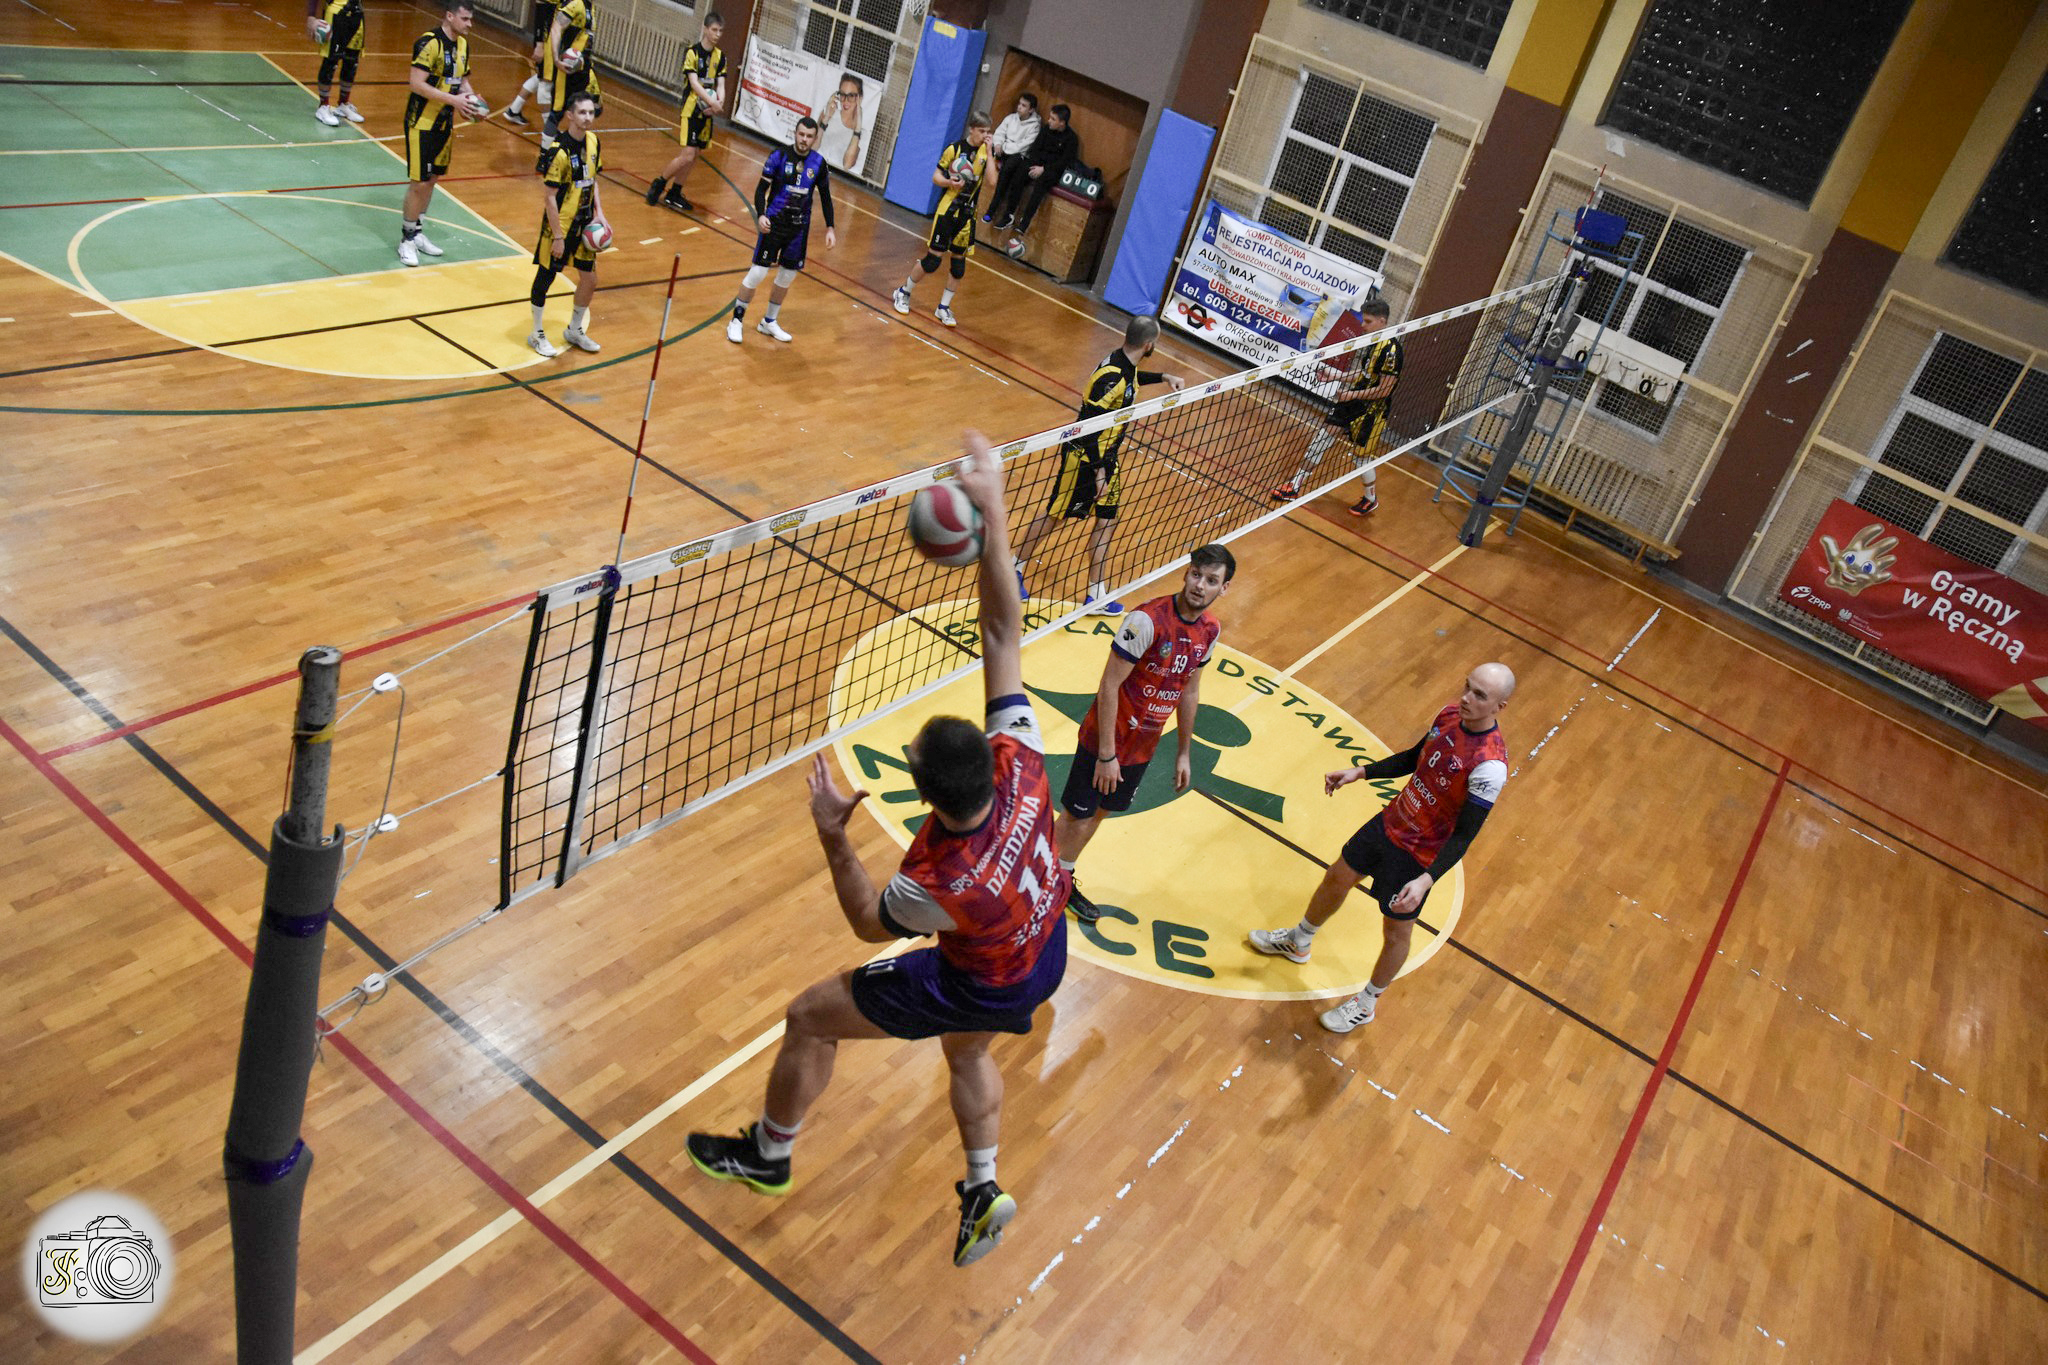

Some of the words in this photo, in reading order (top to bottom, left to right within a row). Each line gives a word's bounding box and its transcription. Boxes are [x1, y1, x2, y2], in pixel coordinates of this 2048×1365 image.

[1062, 173, 1073, 184] 0
[1087, 184, 1097, 195] 0
[1206, 226, 1216, 237] PL
[1245, 228, 1306, 260] KOMPLEKSOWA
[1198, 248, 1228, 270] AUTO
[1229, 264, 1256, 284] MAX
[1218, 226, 1292, 269] REJESTRACJA
[1293, 261, 1360, 296] POJAZDÓW
[1221, 242, 1277, 273] SPROWADZONYCH
[1280, 270, 1321, 293] KRAJOWYCH
[1192, 258, 1214, 273] 57-220
[1244, 286, 1274, 307] Kolejowa
[1274, 300, 1283, 309] 39
[1182, 282, 1201, 300] tel.
[1204, 293, 1228, 312] 609
[1230, 306, 1252, 325] 124
[1256, 318, 1276, 335] 171
[1209, 278, 1302, 333] UBEZPIECZENIA
[1216, 333, 1266, 362] KONTROLI
[1224, 322, 1280, 354] OKRĘGOWA
[1203, 383, 1222, 394] netex
[1059, 425, 1083, 440] netex
[855, 486, 890, 506] netex
[770, 510, 808, 531] GIGANCI
[670, 540, 714, 562] GIGANCI
[573, 578, 606, 596] netex
[1930, 570, 2021, 627] Gramy
[1808, 595, 1832, 610] ZPRP
[1902, 588, 1927, 610] w
[1928, 597, 2026, 665] Ręczną
[1171, 654, 1189, 674] 59
[1428, 750, 1441, 768] 8
[1404, 786, 1422, 809] nilink
[985, 795, 1041, 898] DZIEDZINA
[949, 873, 974, 896] SPS
